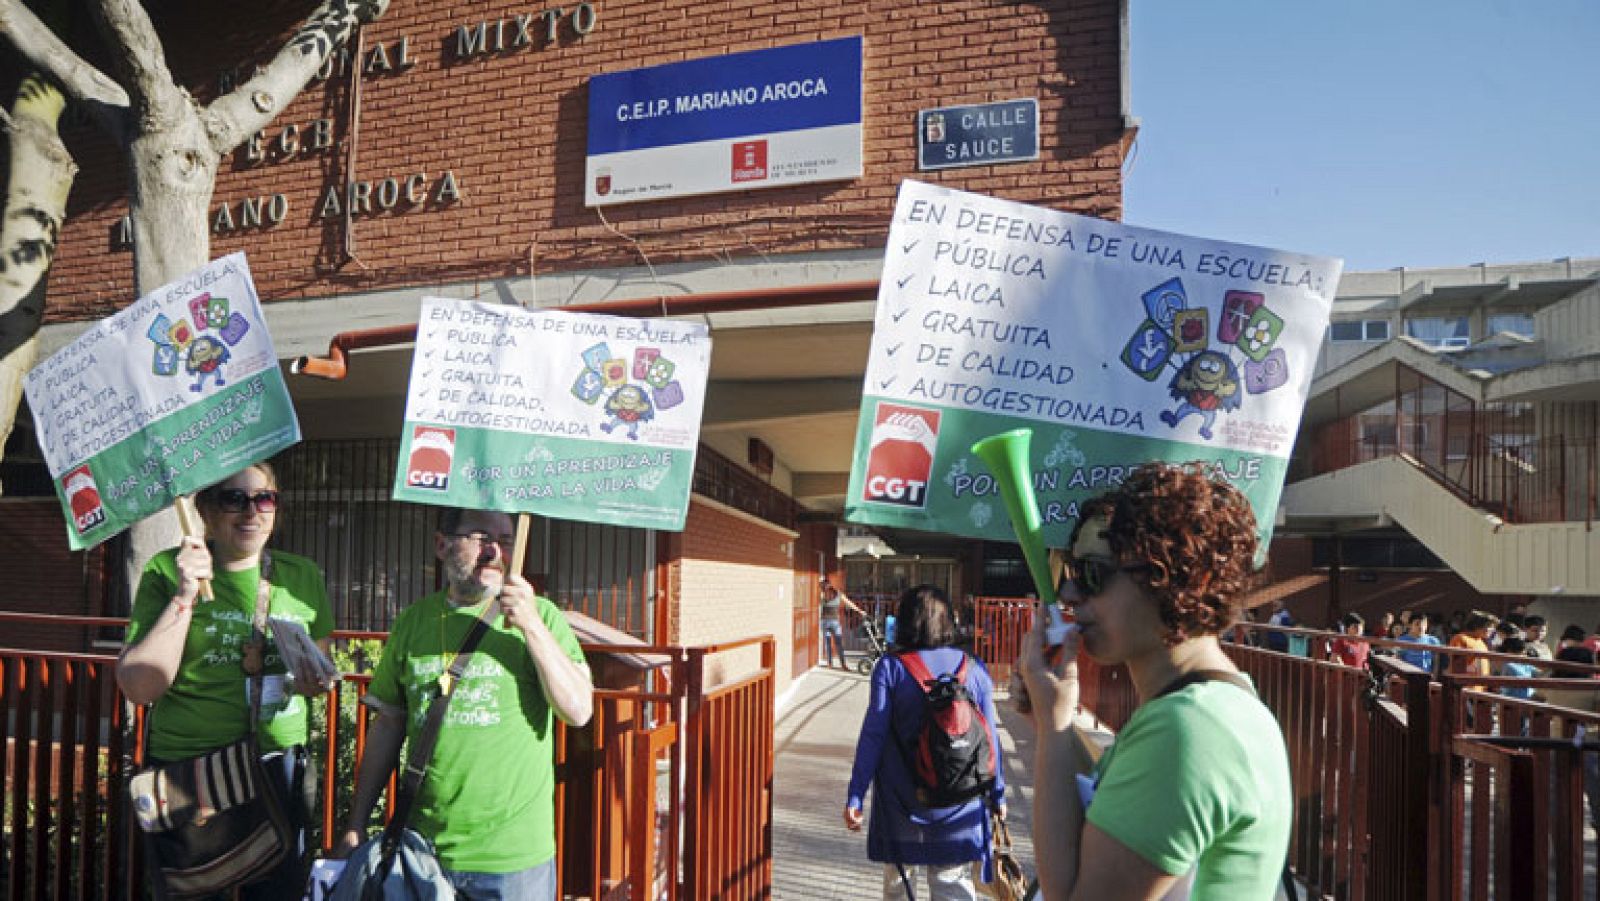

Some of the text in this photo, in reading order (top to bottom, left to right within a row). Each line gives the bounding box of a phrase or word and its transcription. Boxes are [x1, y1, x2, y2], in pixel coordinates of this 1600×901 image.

[457, 3, 597, 56] MIXTO
[616, 77, 828, 122] C.E.I.P. MARIANO AROCA
[961, 107, 1027, 130] CALLE
[945, 137, 1015, 160] SAUCE
[320, 170, 460, 218] AROCA
[908, 199, 947, 225] EN
[956, 207, 1076, 251] DEFENSA
[1086, 232, 1122, 258] DE
[1131, 240, 1186, 270] UNA
[934, 238, 1047, 280] PÚBLICA
[928, 275, 1005, 308] LAICA
[131, 298, 162, 324] UNA
[430, 307, 455, 321] EN
[460, 309, 537, 331] DEFENSA
[543, 317, 567, 333] DE
[572, 321, 609, 337] UNA
[922, 310, 1051, 349] GRATUITA
[443, 349, 494, 366] LAICA
[916, 343, 1075, 385] DE CALIDAD
[440, 368, 524, 389] GRATUITA
[51, 380, 88, 411] LAICA
[55, 385, 118, 430] GRATUITA
[438, 388, 462, 403] DE
[908, 377, 1145, 431] AUTOGESTIONADA
[61, 394, 137, 448] DE CALIDAD
[69, 392, 187, 464] AUTOGESTIONADA
[433, 408, 592, 437] AUTOGESTIONADA
[182, 447, 206, 470] LA
[465, 451, 673, 484] POR UN APRENDIZAJE
[408, 470, 448, 490] CGT
[504, 476, 640, 500] PARA LA VIDA
[867, 475, 926, 502] CGT
[955, 474, 998, 498] PO
